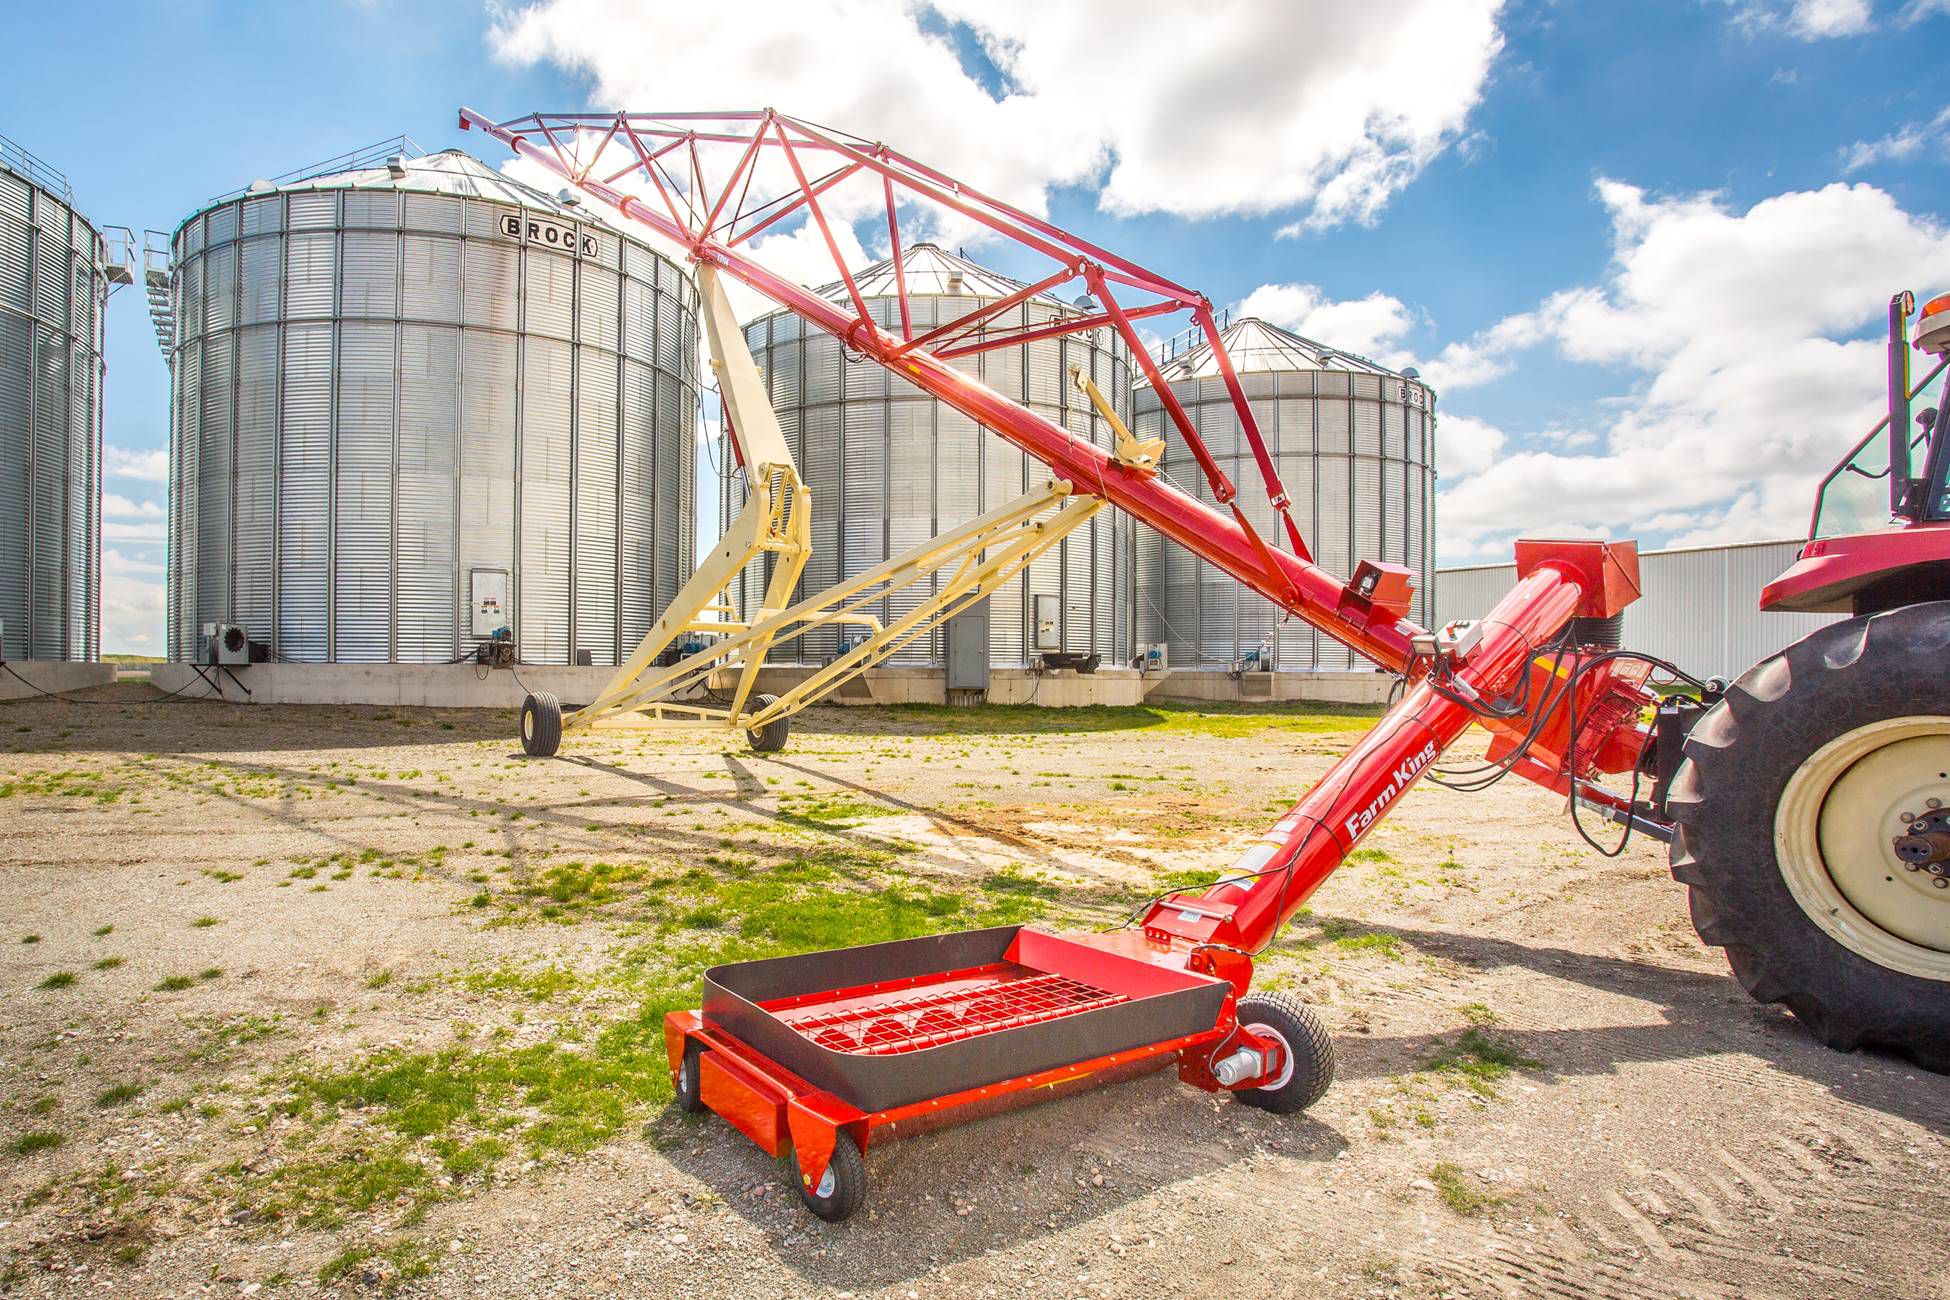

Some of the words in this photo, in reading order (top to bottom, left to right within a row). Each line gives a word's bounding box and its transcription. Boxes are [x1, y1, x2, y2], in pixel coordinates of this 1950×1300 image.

[507, 218, 592, 254] BROCK
[1400, 388, 1424, 405] BROC
[1345, 783, 1397, 840] Farm
[1393, 740, 1436, 789] King
